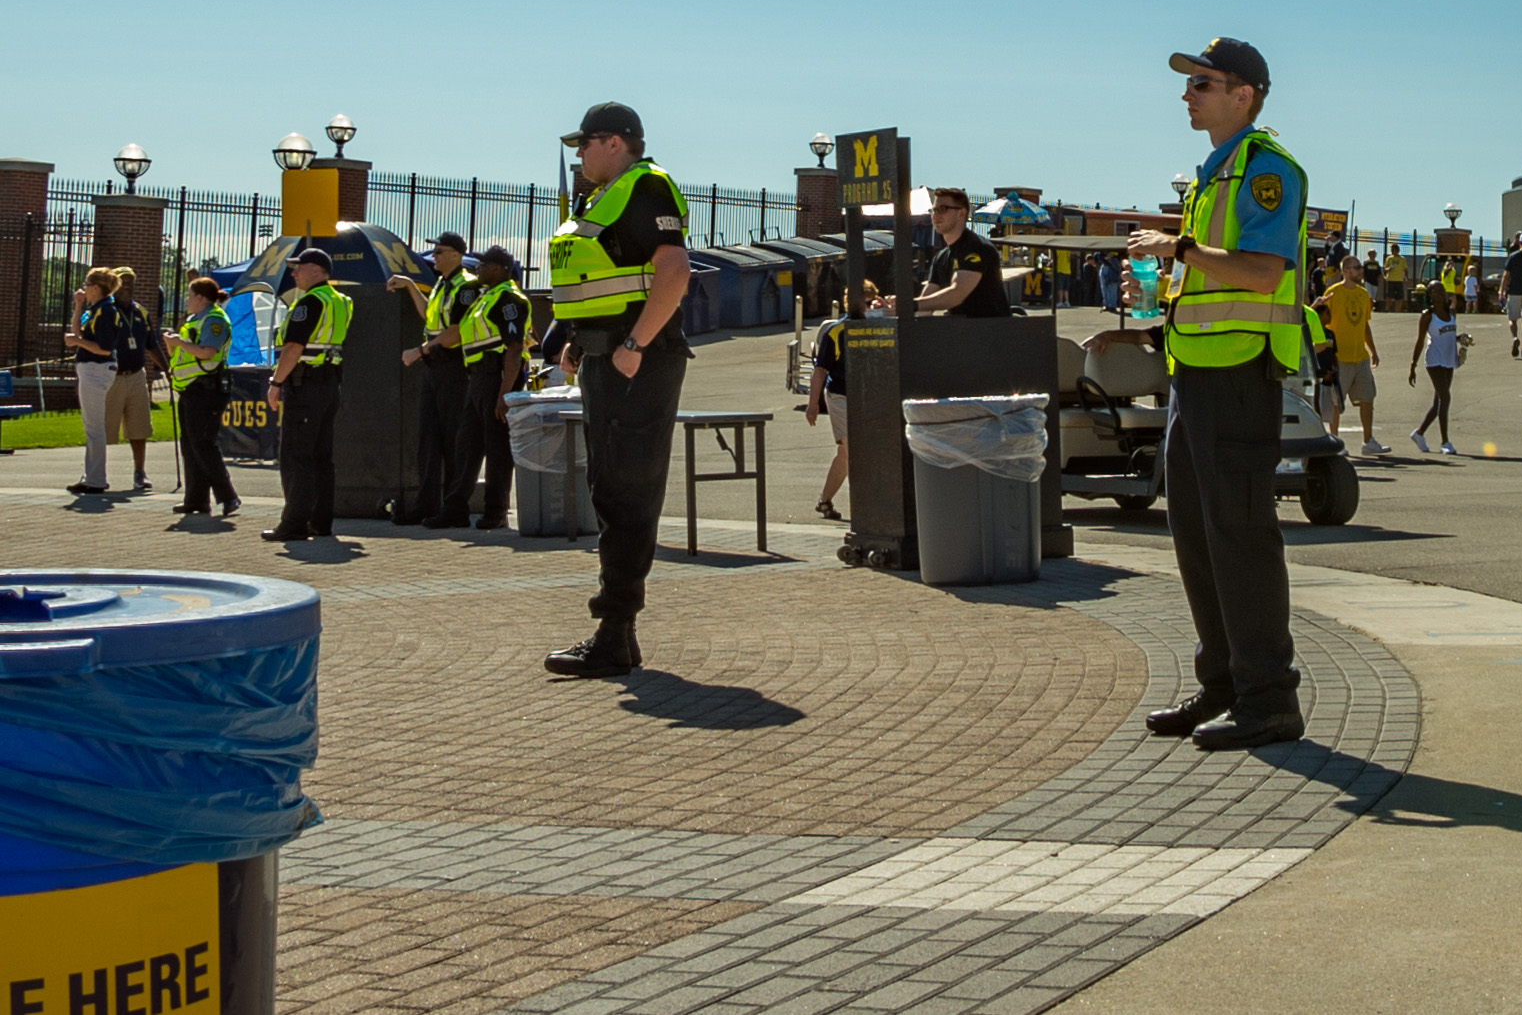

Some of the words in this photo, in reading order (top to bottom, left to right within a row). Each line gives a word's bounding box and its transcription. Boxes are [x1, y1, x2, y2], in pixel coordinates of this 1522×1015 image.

[853, 134, 879, 178] M
[250, 242, 297, 277] M
[373, 240, 422, 274] M
[1023, 272, 1043, 296] M
[68, 940, 210, 1015] HERE
